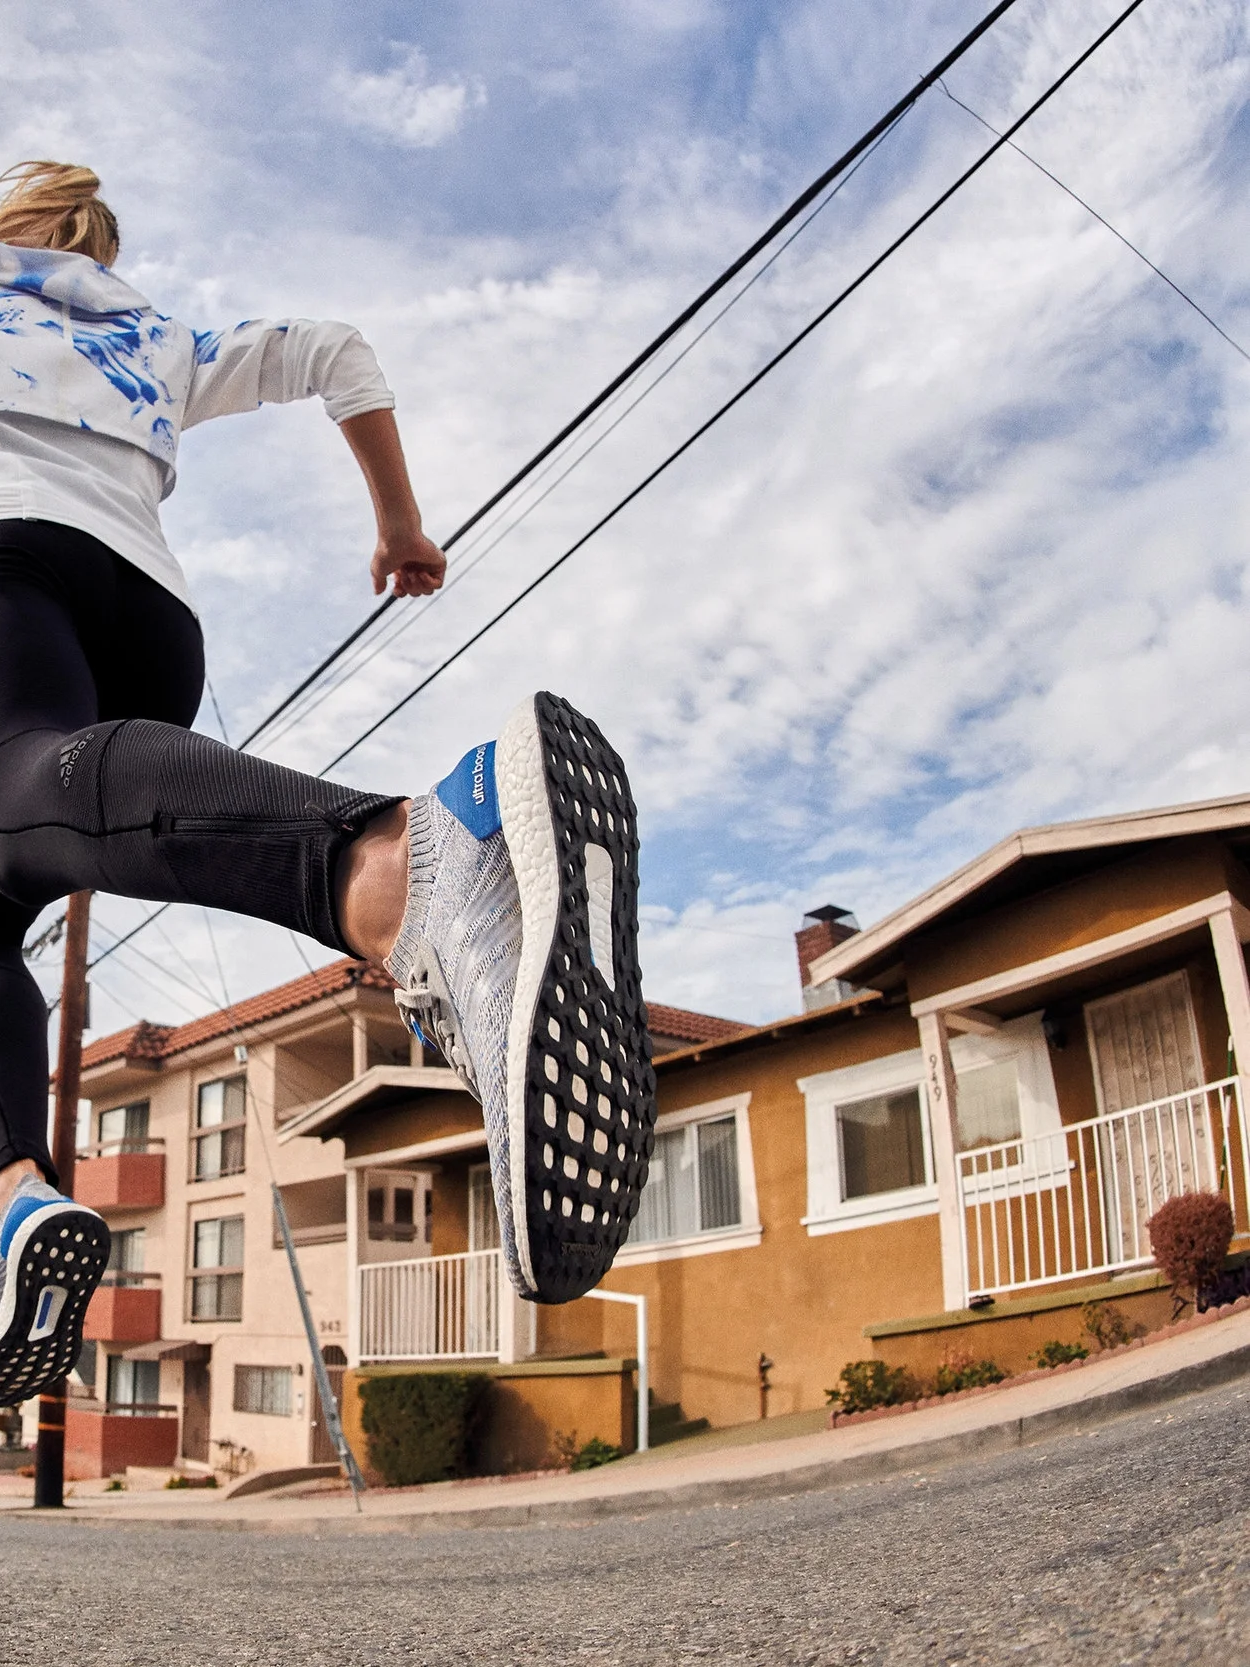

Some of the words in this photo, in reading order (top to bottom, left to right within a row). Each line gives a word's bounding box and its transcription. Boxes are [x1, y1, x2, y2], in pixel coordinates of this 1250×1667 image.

[63, 733, 94, 788] adidas
[472, 744, 487, 774] boos
[472, 774, 485, 805] ultra
[929, 1054, 942, 1102] 949
